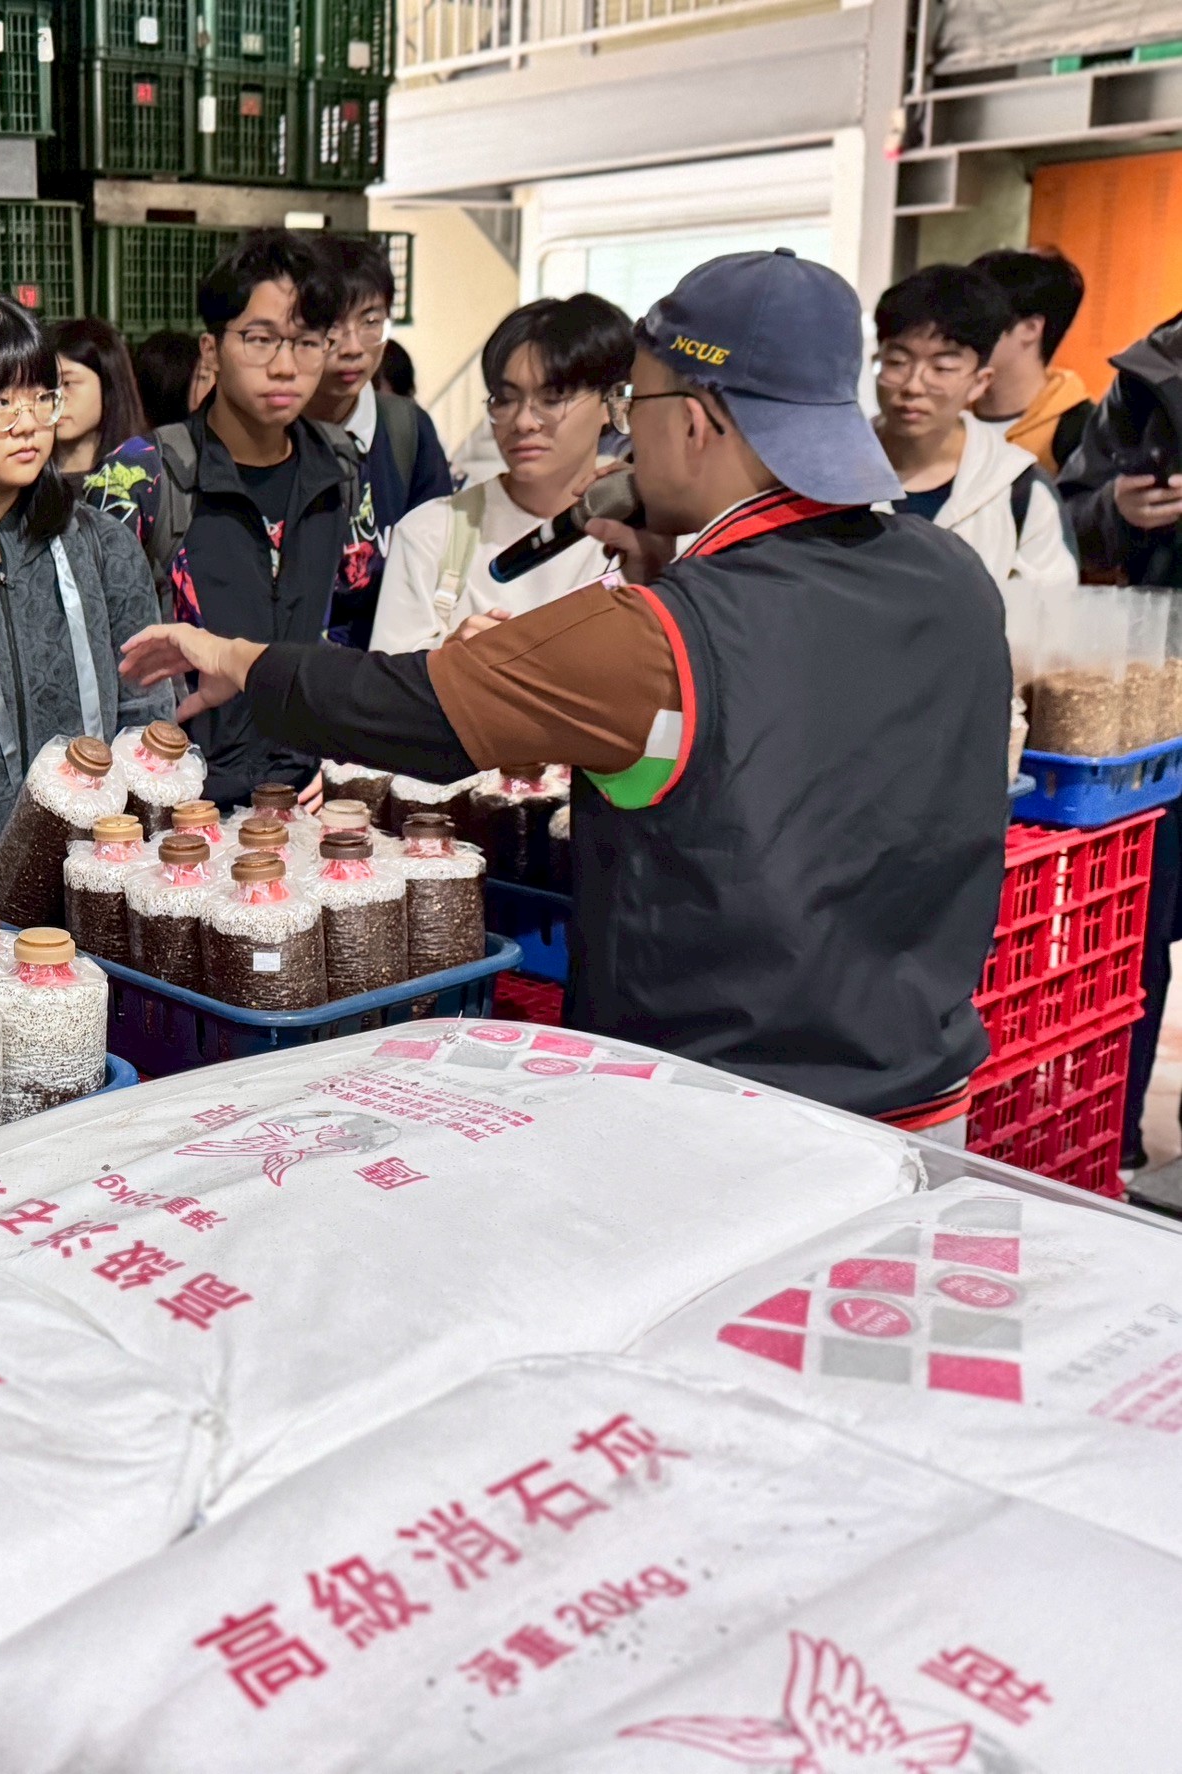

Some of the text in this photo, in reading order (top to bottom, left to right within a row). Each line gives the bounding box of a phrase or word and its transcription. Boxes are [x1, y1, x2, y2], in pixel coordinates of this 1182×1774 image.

[670, 335, 731, 365] NCUE
[92, 1173, 168, 1207] 20kg
[194, 1412, 691, 1710] 高級消石灰
[458, 1562, 688, 1697] 淨重 20kg
